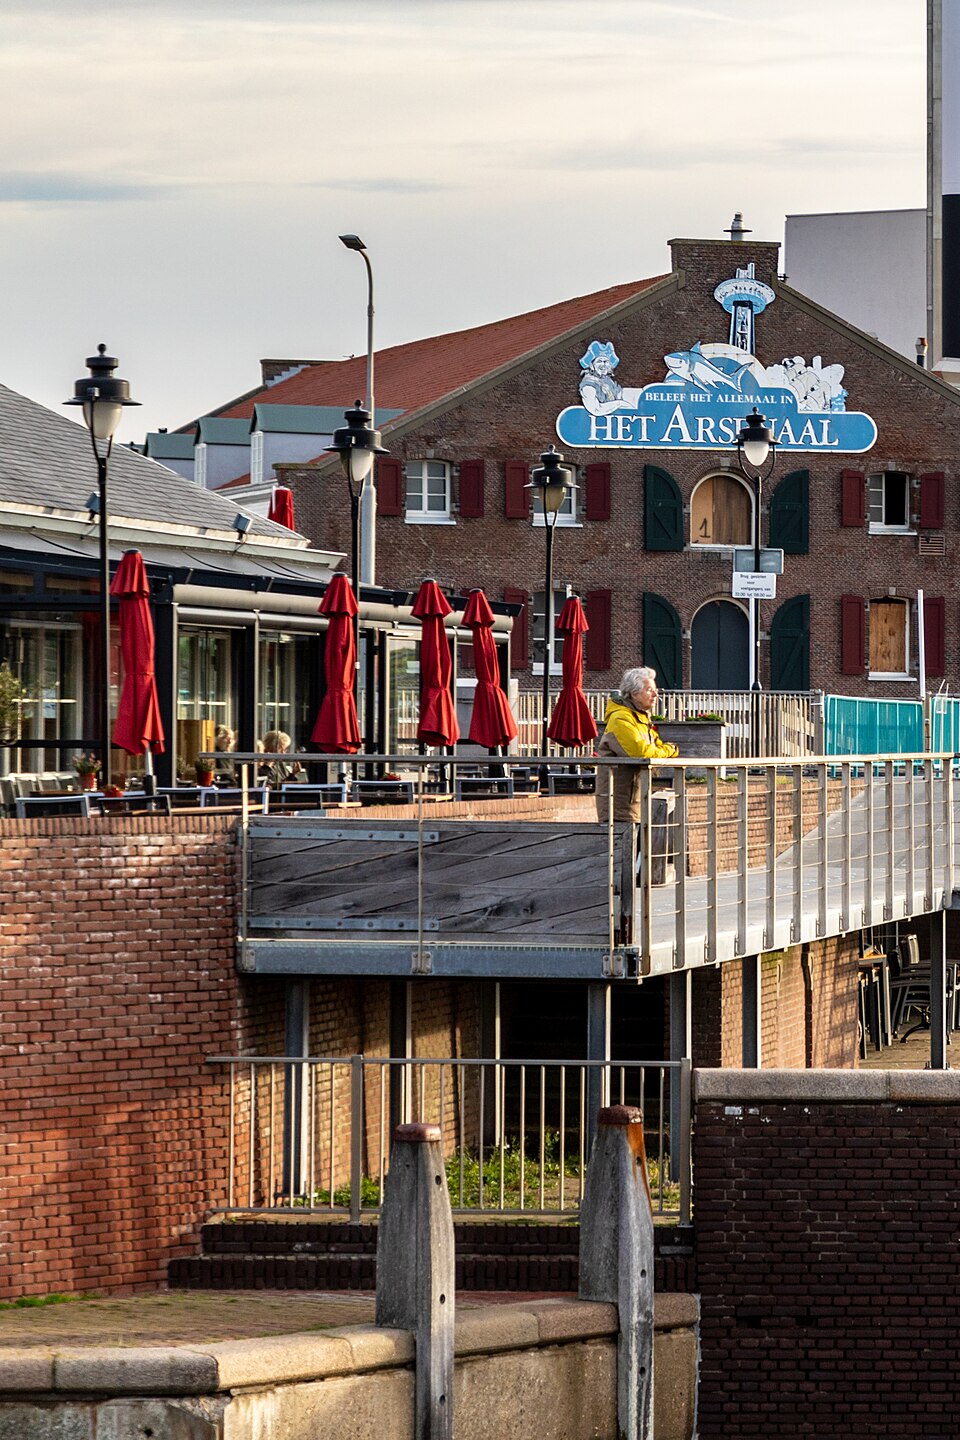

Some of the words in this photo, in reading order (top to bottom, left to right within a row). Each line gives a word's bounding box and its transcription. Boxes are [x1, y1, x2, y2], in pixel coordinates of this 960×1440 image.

[645, 392, 686, 402] BELEEF
[690, 393, 712, 402] HET
[716, 394, 777, 404] ALLEMAAL
[781, 395, 793, 404] IN
[587, 415, 656, 442] HET
[660, 403, 839, 446] ARSAAL
[699, 518, 711, 538] 1
